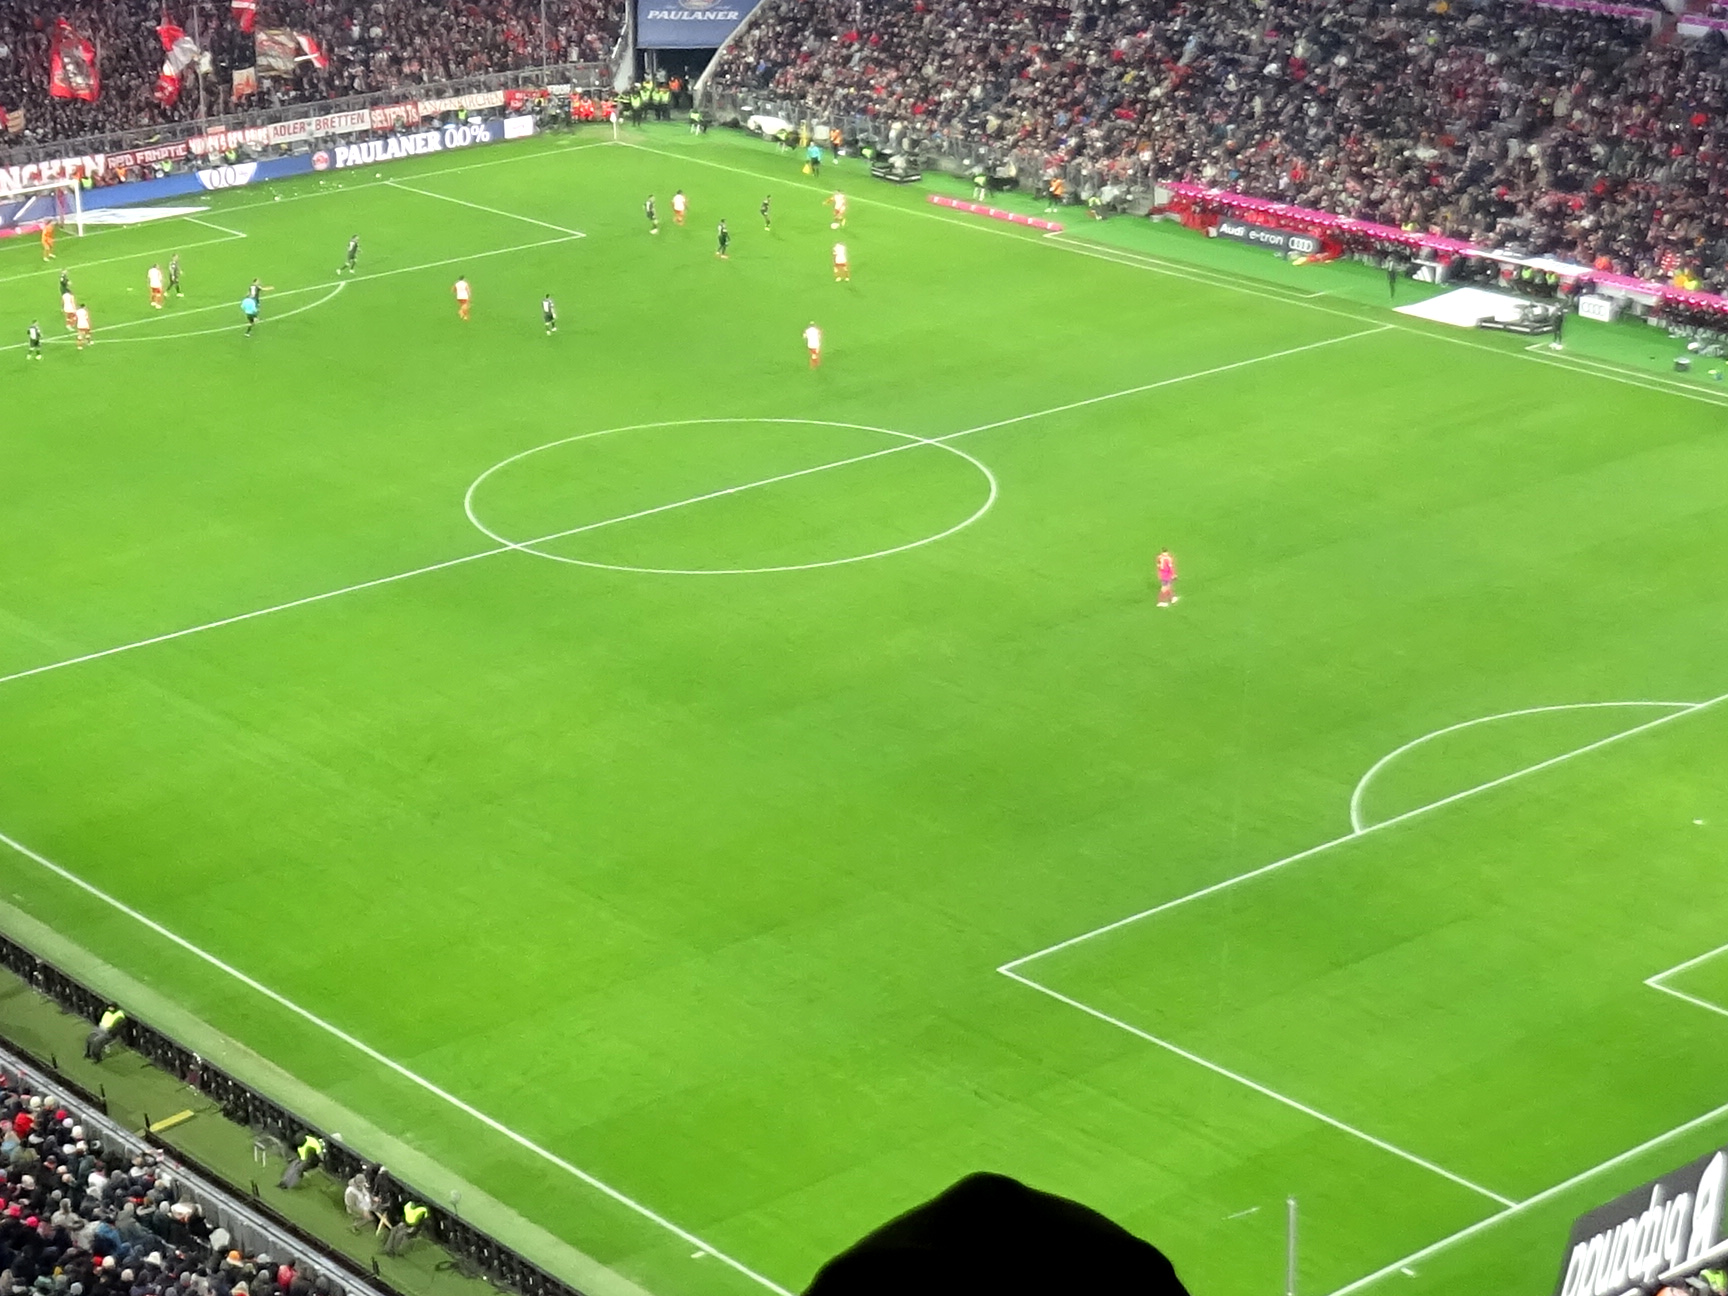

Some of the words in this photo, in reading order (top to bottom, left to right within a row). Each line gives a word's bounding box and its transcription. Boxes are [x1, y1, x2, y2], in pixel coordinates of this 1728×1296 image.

[647, 10, 739, 20] PAULANER
[273, 124, 306, 138] ADLER
[315, 112, 365, 131] BRETTEN
[335, 132, 441, 168] PAULANER
[1219, 223, 1244, 237] Audi
[1248, 230, 1283, 245] e-tron
